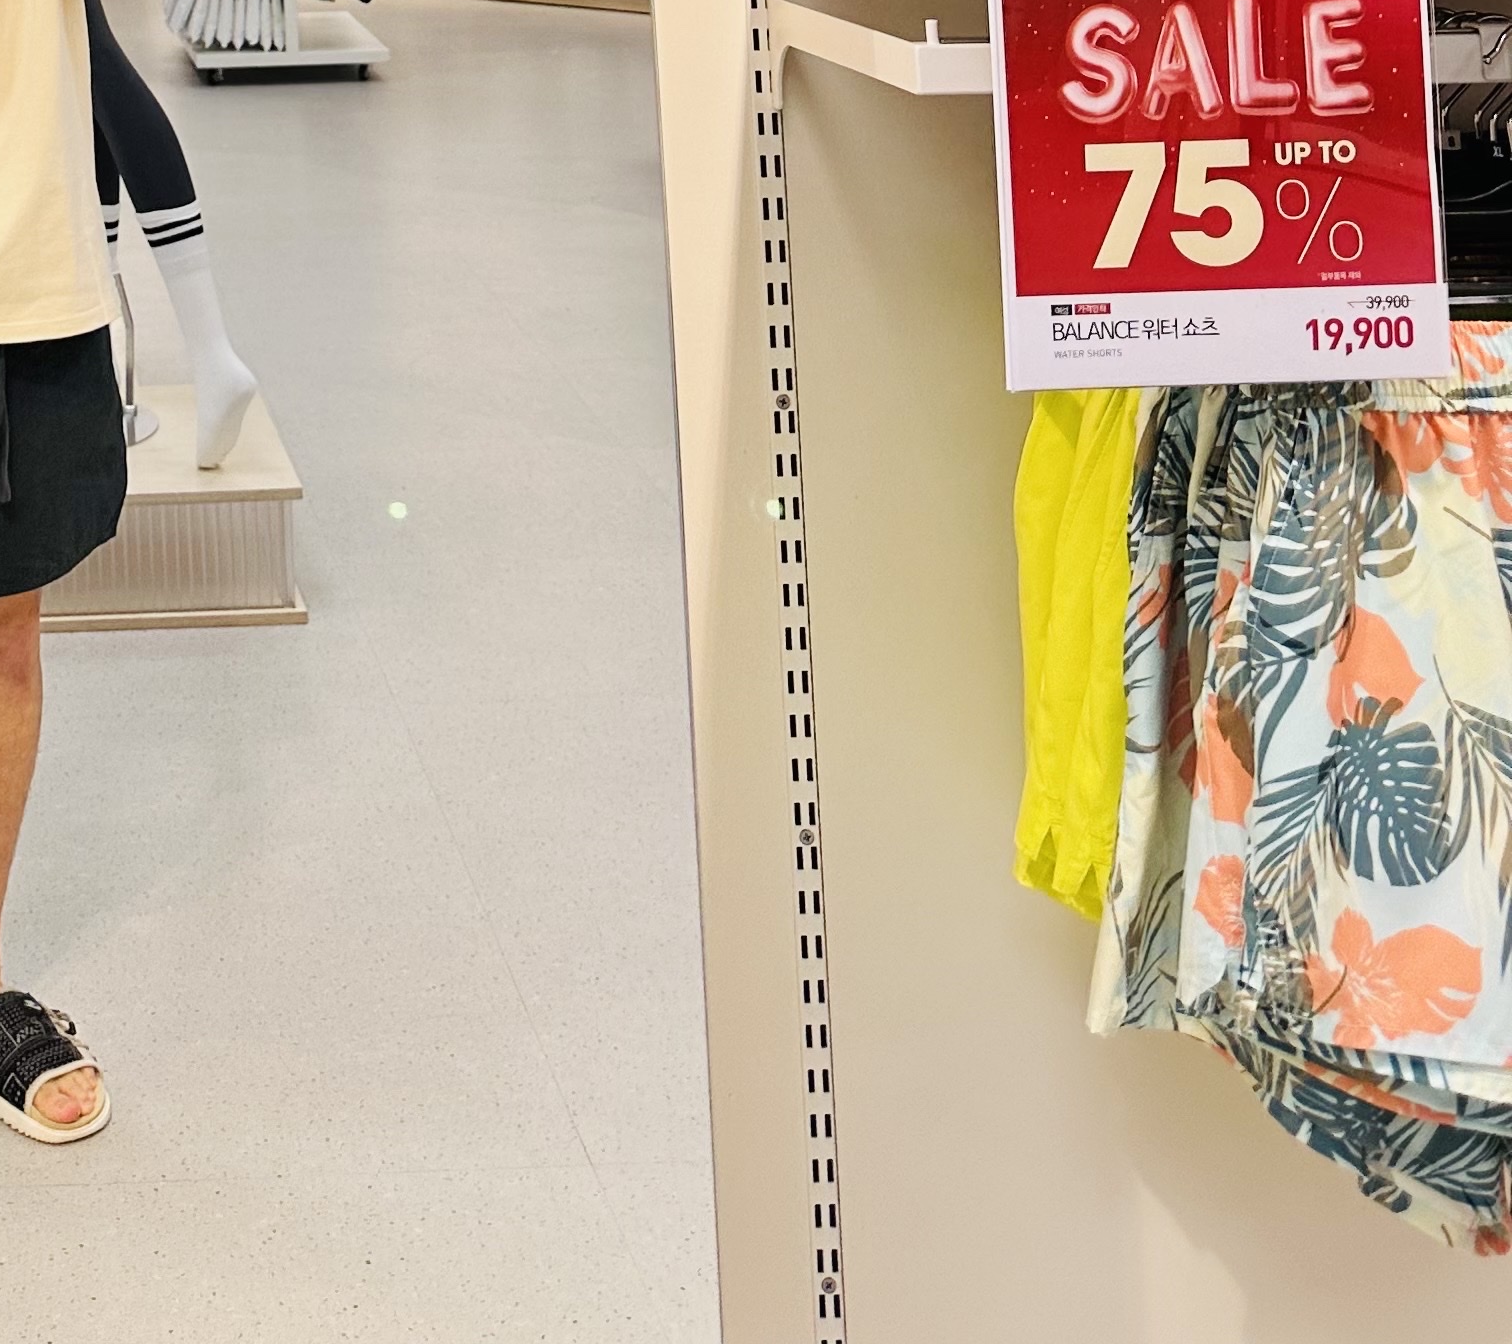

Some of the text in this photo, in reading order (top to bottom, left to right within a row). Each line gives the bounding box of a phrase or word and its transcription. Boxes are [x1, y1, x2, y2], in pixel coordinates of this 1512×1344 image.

[1274, 138, 1357, 166] UP TO
[1366, 295, 1410, 311] 39,900
[1053, 316, 1221, 343] BALANCE 워터 쇼츠
[1305, 315, 1415, 355] 19,900
[1054, 349, 1085, 360] WATER
